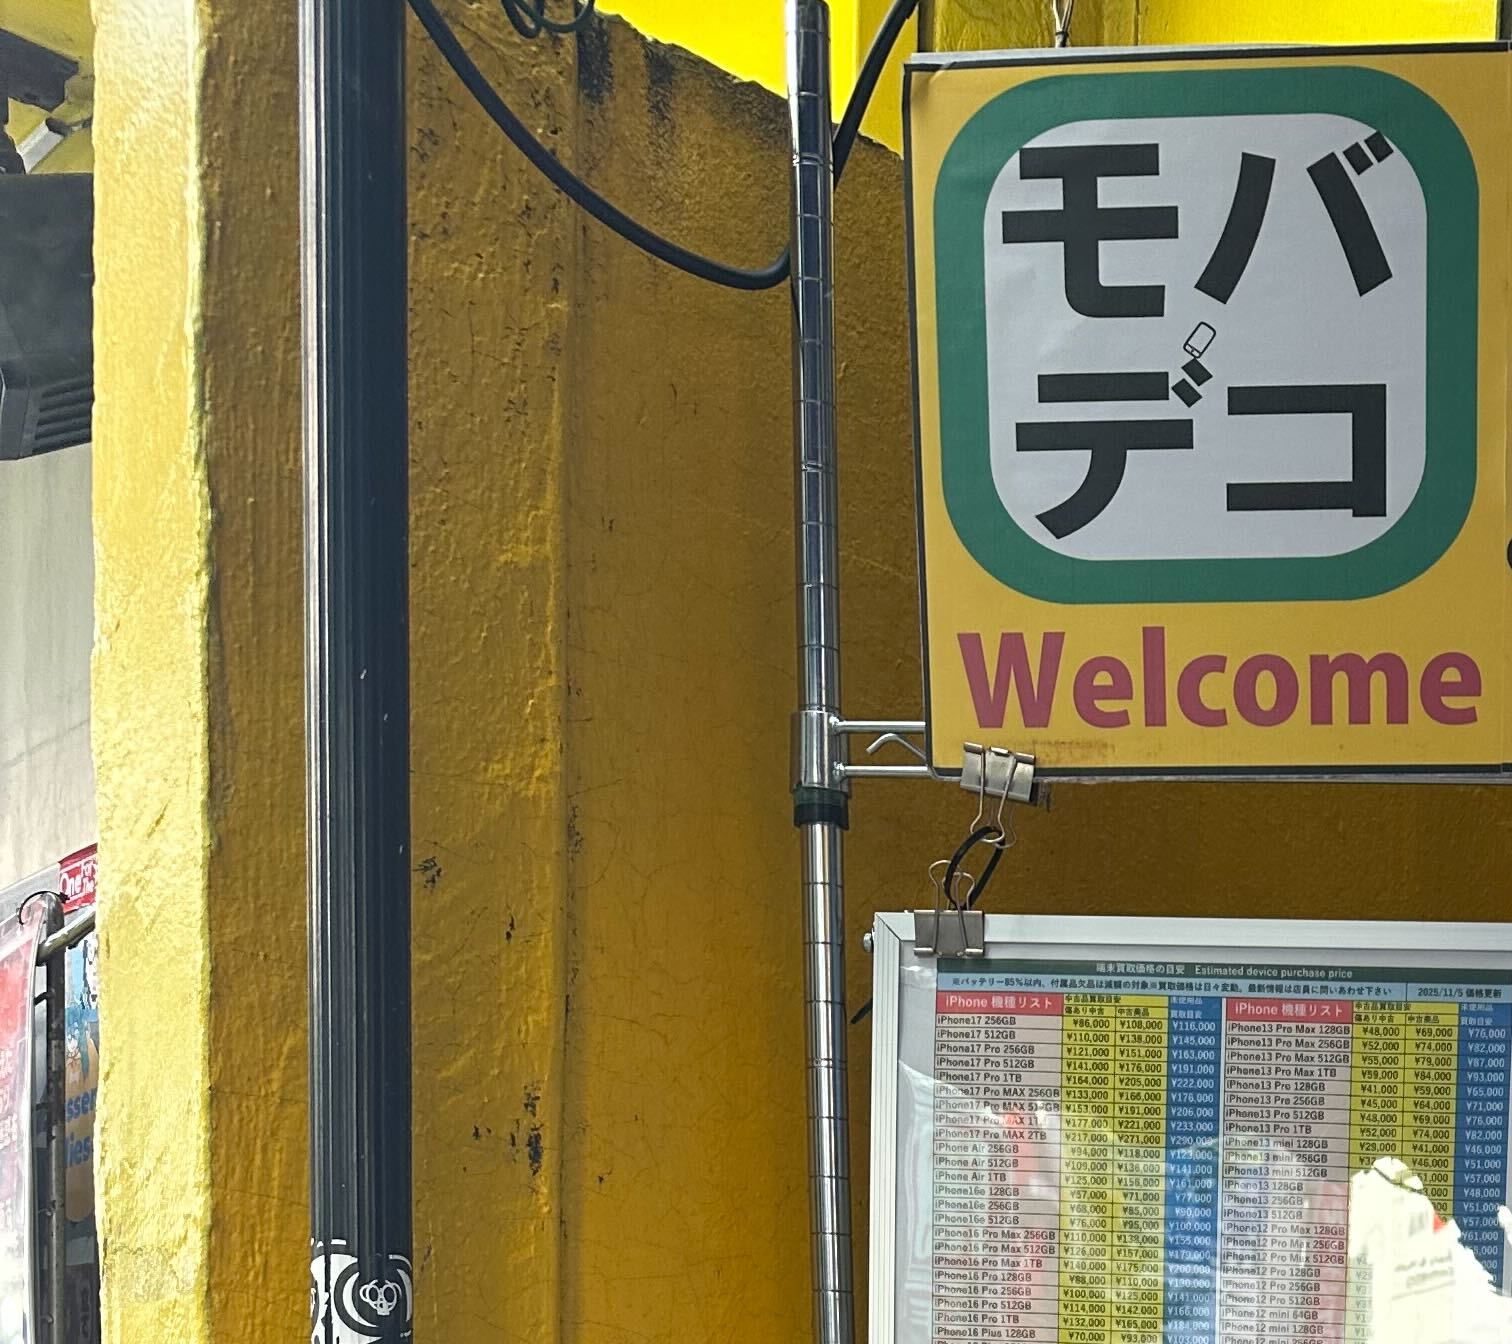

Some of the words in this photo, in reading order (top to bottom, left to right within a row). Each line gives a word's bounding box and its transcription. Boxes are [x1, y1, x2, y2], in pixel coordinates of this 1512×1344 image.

[1001, 132, 1395, 319] モバ
[1015, 359, 1389, 538] デコ
[959, 624, 1484, 731] Welcome
[1195, 965, 1244, 977] Estimated
[1247, 967, 1278, 978] device
[1281, 968, 1326, 980] purchase
[1328, 969, 1353, 981] price
[946, 996, 988, 1008] iPhone
[992, 998, 1052, 1009] 機種リスト
[1235, 1004, 1278, 1016] iPhone
[1282, 1004, 1343, 1018] 機種リスト
[938, 1016, 981, 1026] iPhone17
[986, 1016, 1016, 1026] 256GB
[1073, 1018, 1110, 1029] ¥86,000
[1120, 1020, 1163, 1031] ¥108,000
[938, 1030, 981, 1040] iPhone17
[984, 1031, 1016, 1040] 512GB
[1067, 1032, 1110, 1044] ¥110,000
[1119, 1034, 1162, 1045] ¥138,000
[1228, 1024, 1273, 1034] iPhone13
[1276, 1025, 1292, 1034] Pro
[1296, 1025, 1316, 1034] Max
[1319, 1025, 1350, 1034] 128GB
[1363, 1027, 1400, 1037] ¥48,000
[1416, 1028, 1453, 1037] ¥69,000
[1468, 1029, 1505, 1039] ¥76,000
